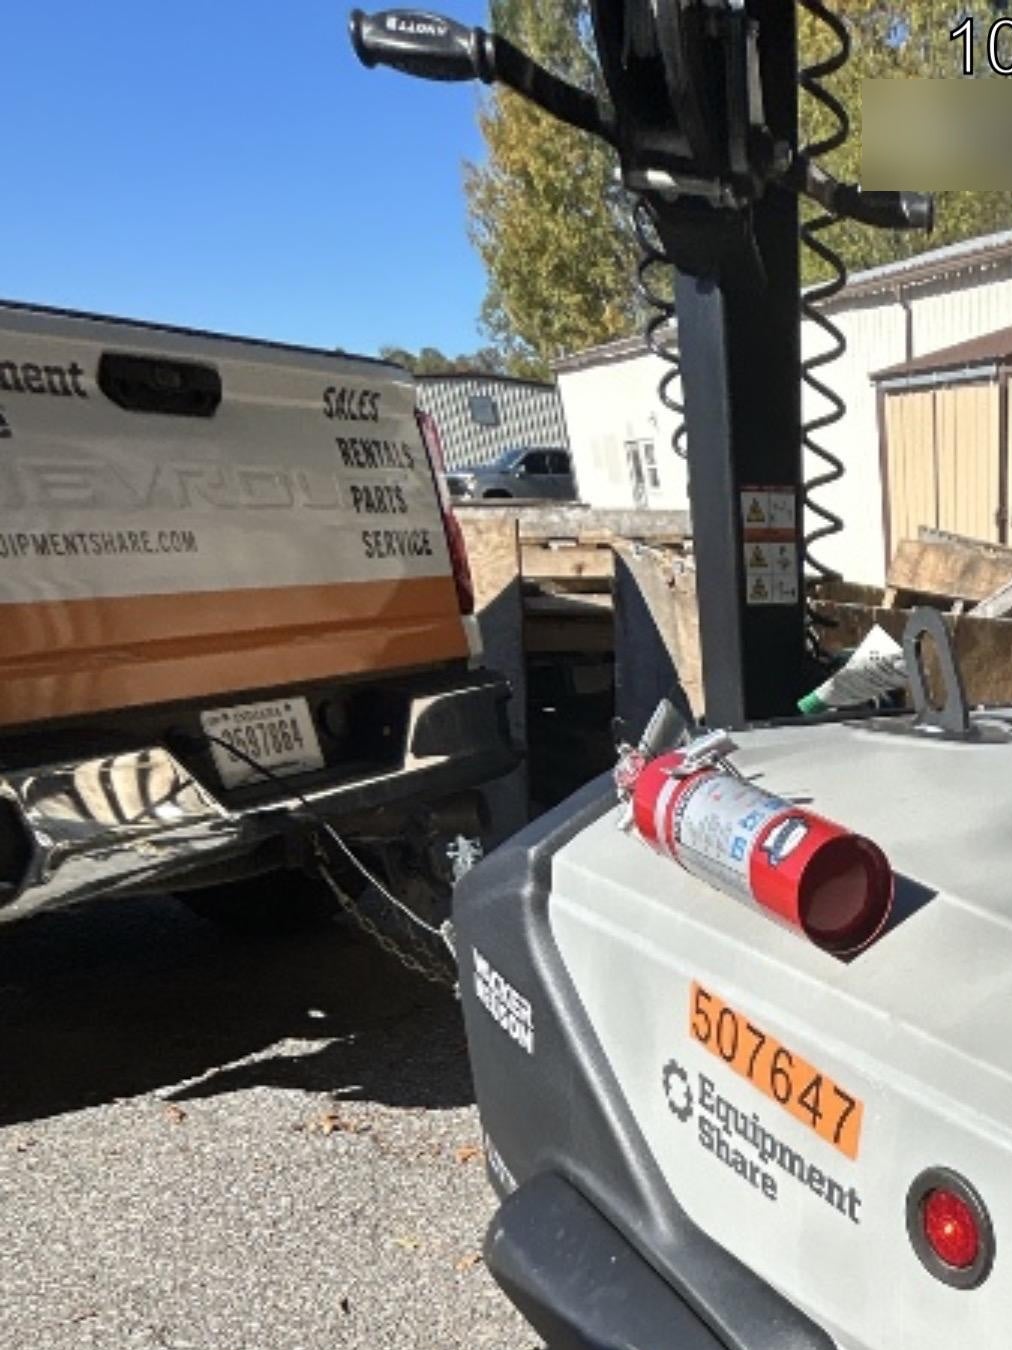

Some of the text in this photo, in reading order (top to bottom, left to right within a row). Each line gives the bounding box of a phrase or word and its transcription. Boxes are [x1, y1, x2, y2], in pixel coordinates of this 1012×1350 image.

[323, 386, 381, 422] SALES
[336, 437, 414, 469] RENTALS
[351, 485, 408, 514] PARTS
[362, 530, 432, 558] SERVICE
[692, 989, 856, 1143] 507647
[698, 1073, 862, 1224] Equipment
[699, 1116, 778, 1201] Share
